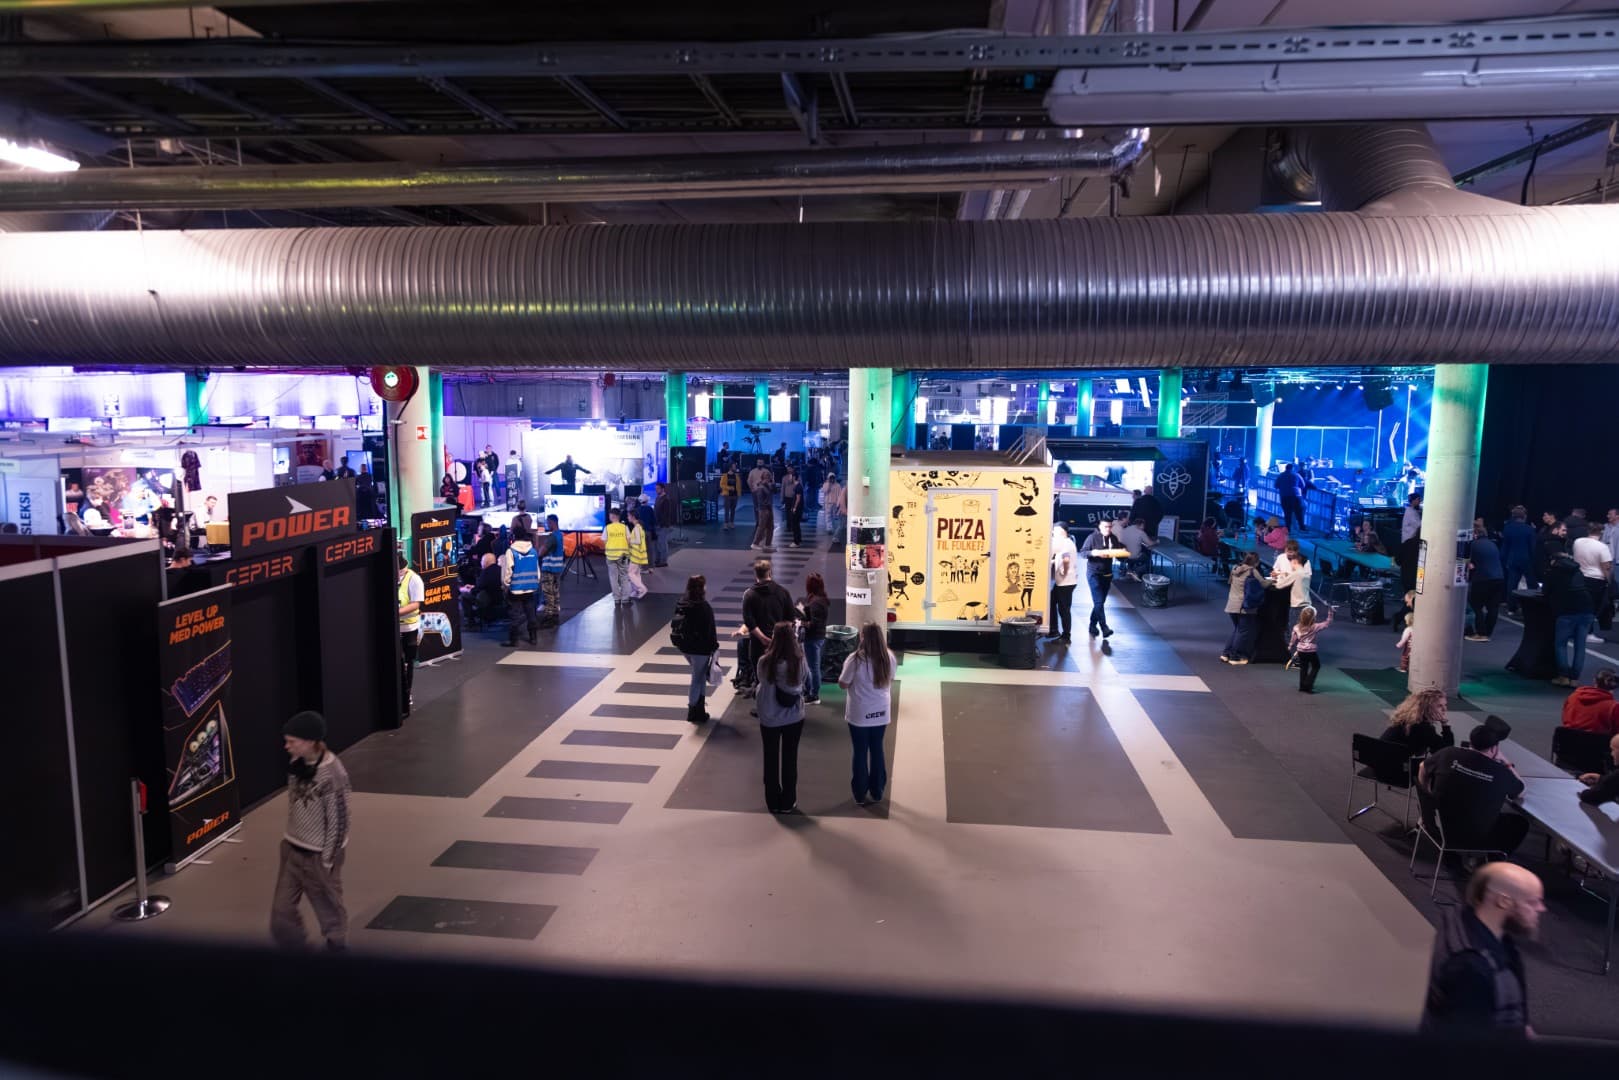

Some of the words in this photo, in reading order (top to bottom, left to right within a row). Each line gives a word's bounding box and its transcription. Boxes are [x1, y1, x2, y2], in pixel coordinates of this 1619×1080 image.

[241, 506, 350, 547] POWER
[420, 519, 450, 529] POWER
[936, 518, 986, 540] PIZZA
[937, 540, 949, 550] TIL
[424, 594, 441, 605] GAME
[425, 586, 441, 598] GEAR
[175, 608, 204, 628] LEVEL
[205, 605, 219, 619] UP
[169, 627, 191, 645] MED
[191, 616, 225, 638] POWER
[865, 710, 886, 719] CREW
[185, 811, 230, 845] POWER
